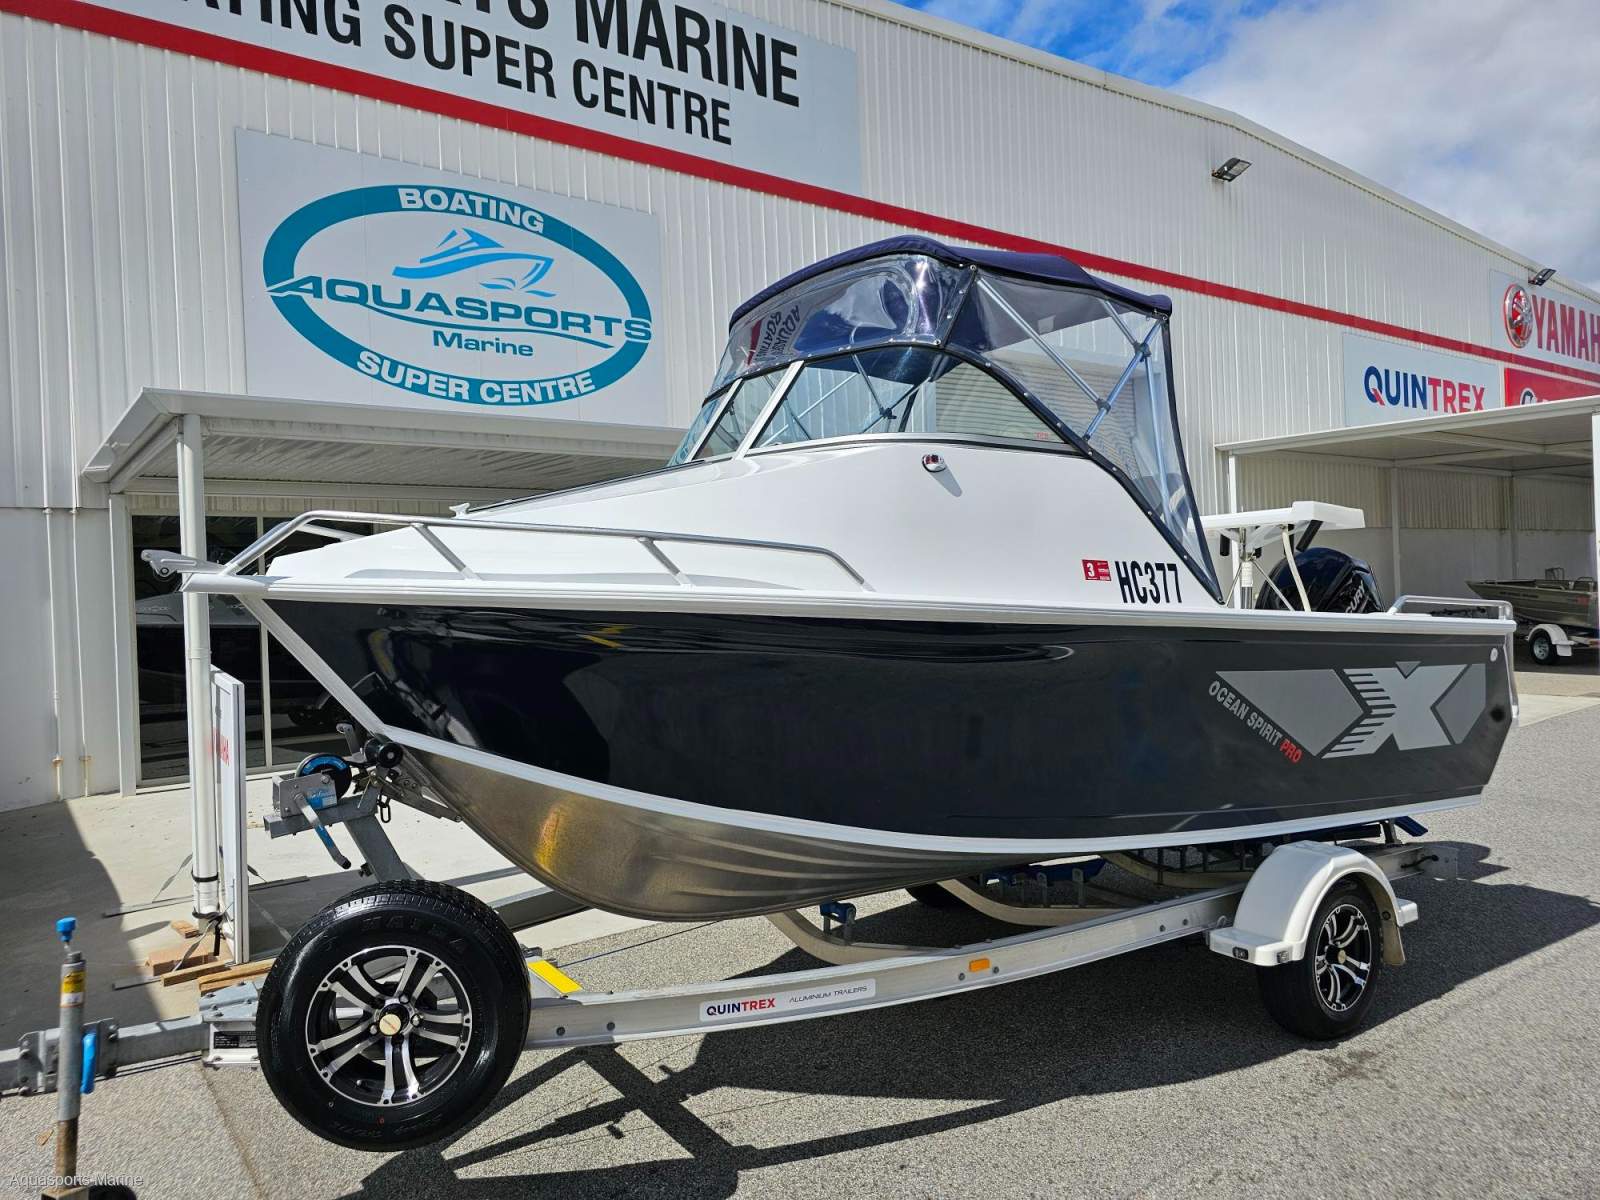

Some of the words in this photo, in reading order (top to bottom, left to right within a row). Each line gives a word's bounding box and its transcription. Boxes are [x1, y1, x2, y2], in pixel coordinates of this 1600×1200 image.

[384, 4, 557, 99] SUPER
[573, 58, 733, 146] CENTRE
[575, 0, 800, 108] MARINE
[398, 188, 545, 233] BOATING
[266, 275, 652, 341] AQUASPORTS
[432, 330, 535, 357] Marine
[356, 350, 471, 401] SUPER
[479, 370, 597, 404] CENTRE
[1363, 365, 1486, 414] QUINTREX
[1086, 562, 1096, 577] 3
[1114, 560, 1183, 604] HC377
[1208, 680, 1250, 721] OCEAN
[1246, 711, 1284, 747] SPIRIT
[1279, 738, 1303, 764] PRO
[706, 998, 776, 1016] QUINTREX
[788, 992, 832, 1004] ALUMINIUM
[833, 985, 868, 996] TRAILERS
